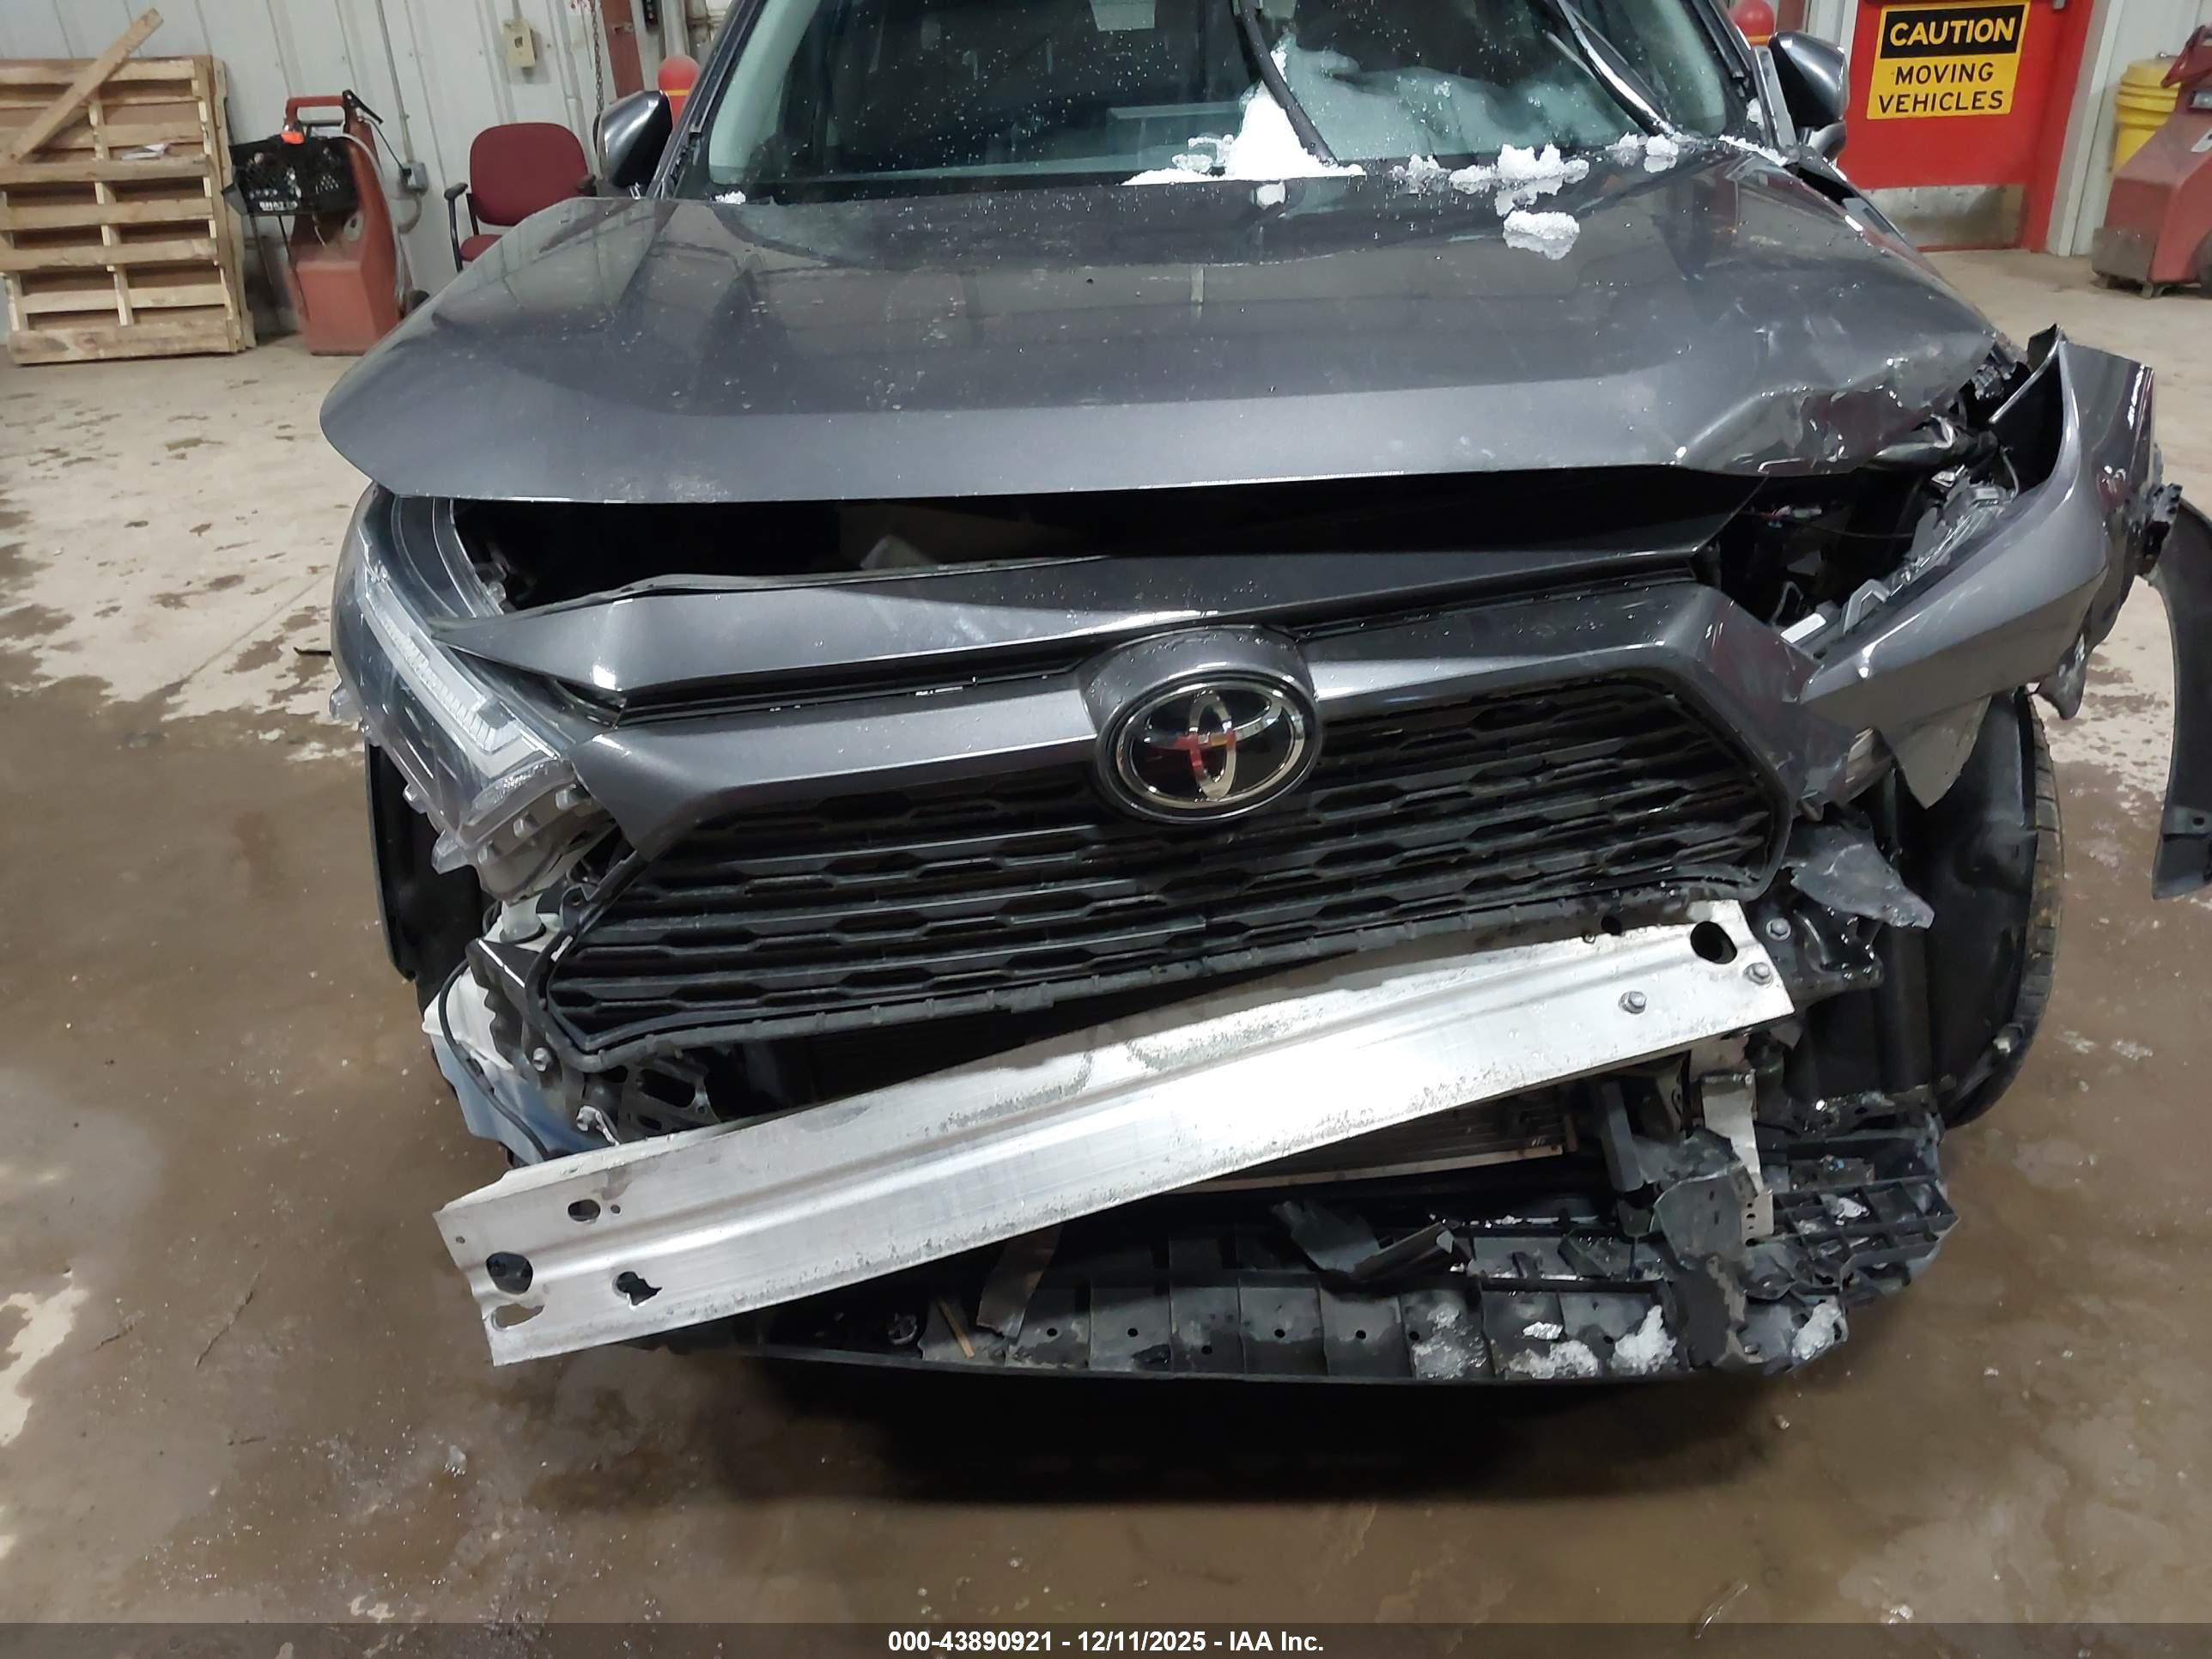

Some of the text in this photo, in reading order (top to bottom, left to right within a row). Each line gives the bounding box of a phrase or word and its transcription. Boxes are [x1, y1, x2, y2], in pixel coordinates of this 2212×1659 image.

[1890, 17, 2016, 46] CAUTION
[1895, 62, 1994, 85] MOVING
[1879, 90, 2003, 113] VEHICLES
